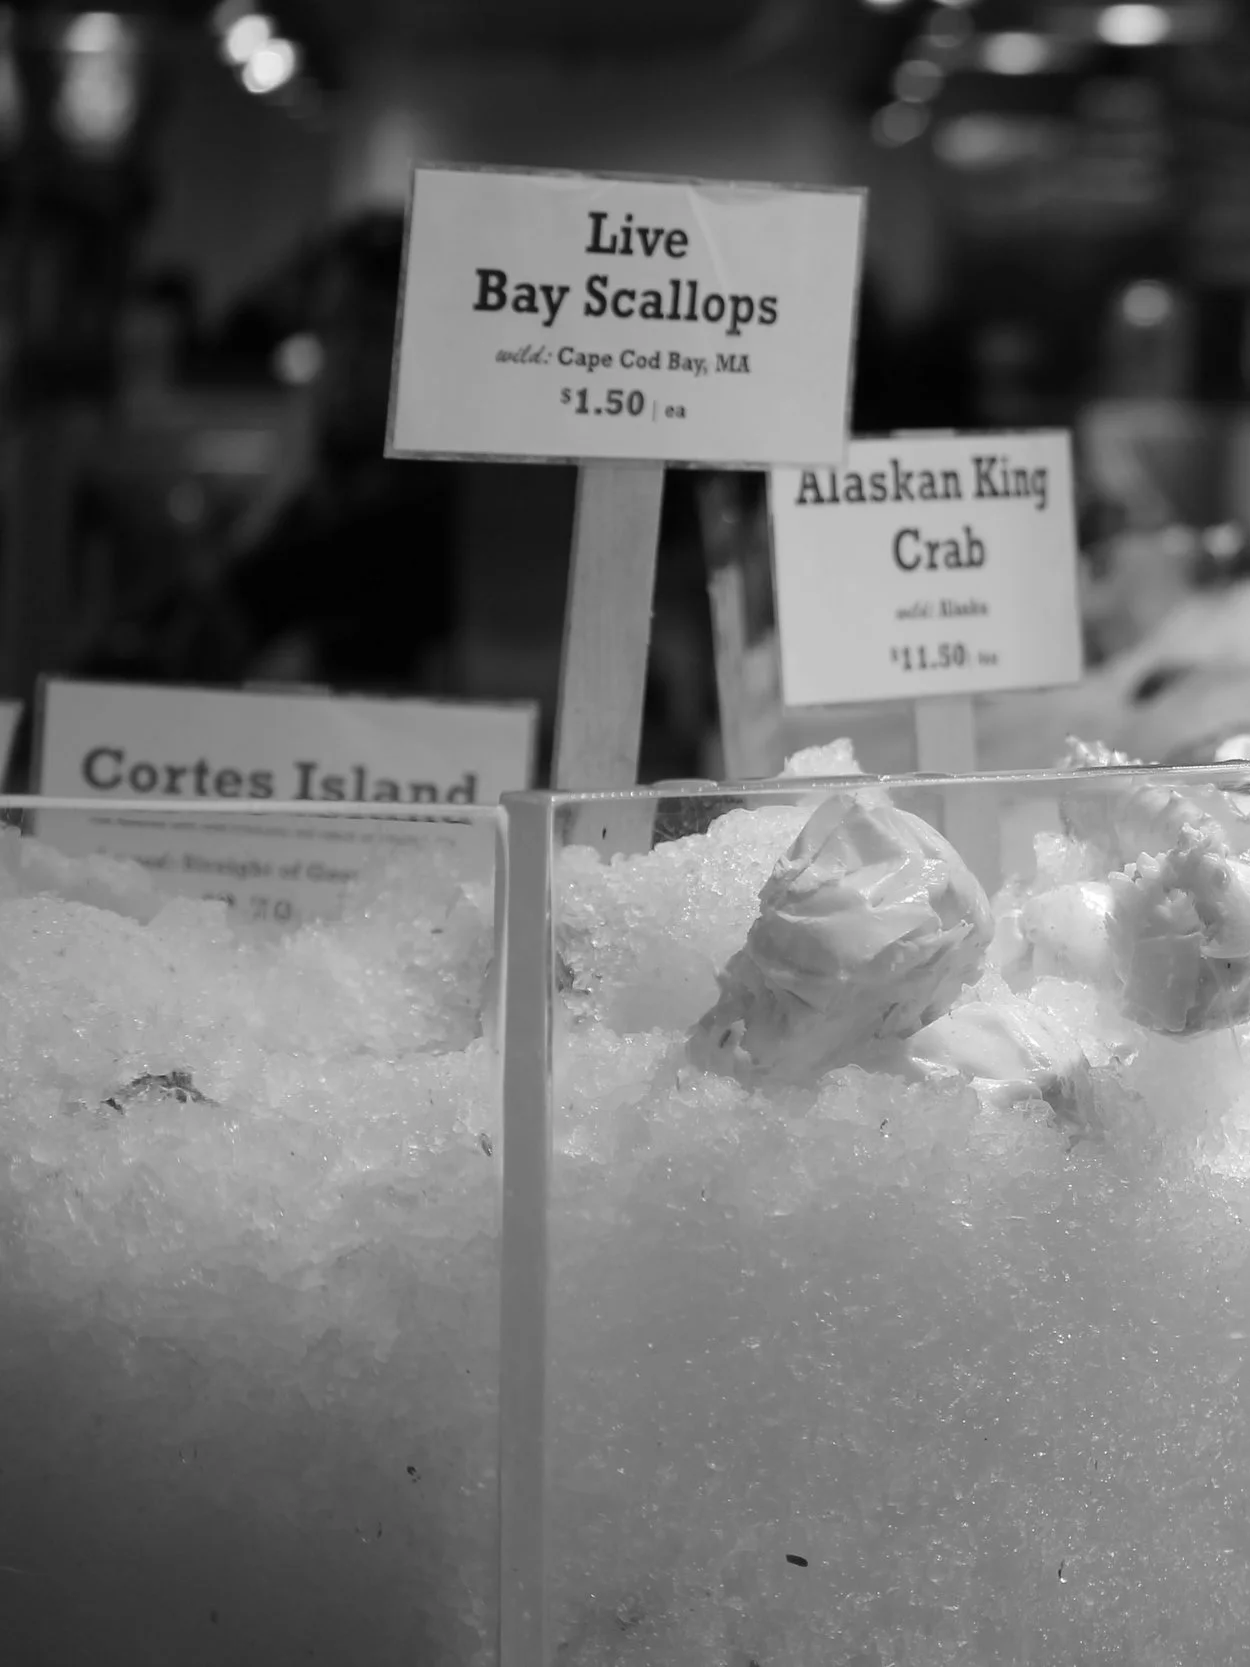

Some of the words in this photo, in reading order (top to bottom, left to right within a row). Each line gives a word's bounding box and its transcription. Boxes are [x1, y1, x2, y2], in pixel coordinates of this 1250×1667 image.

[585, 211, 690, 259] Live
[472, 268, 571, 328] Bay
[583, 274, 778, 337] Scallops
[495, 344, 553, 366] wild:
[557, 346, 614, 374] Cape
[619, 349, 662, 371] Cod
[667, 351, 709, 378] Bay,
[714, 352, 752, 375] MA
[560, 386, 646, 418] $1.50
[664, 404, 687, 420] ea
[795, 457, 963, 506] Alaskan
[971, 453, 1048, 511] King
[892, 525, 987, 572] Crab
[81, 745, 277, 800] Cortes
[293, 760, 479, 804] Island
